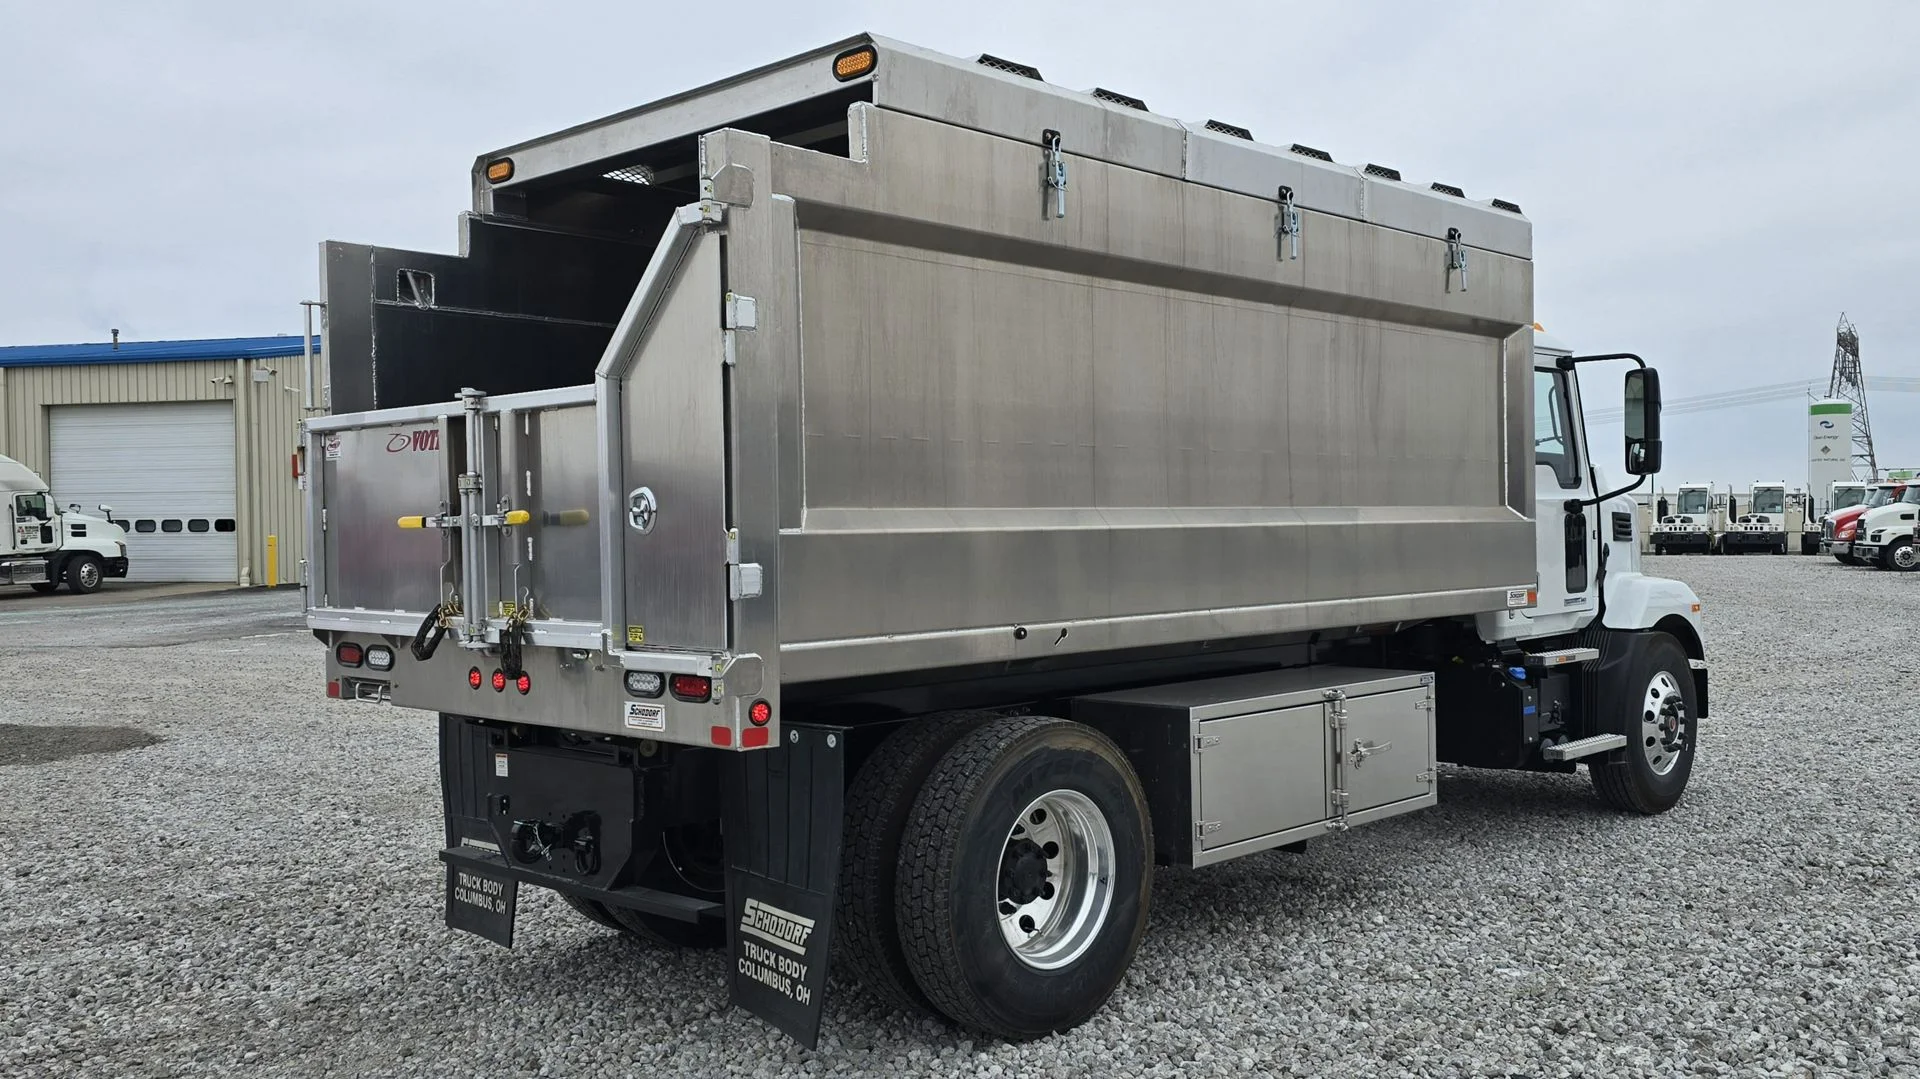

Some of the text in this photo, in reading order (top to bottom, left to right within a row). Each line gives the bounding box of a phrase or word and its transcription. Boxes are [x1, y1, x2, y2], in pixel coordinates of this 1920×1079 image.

[454, 887, 507, 915] COLUMBUS, OH
[459, 872, 504, 897] TRUCK BODY
[741, 898, 812, 946] SCHODORF
[743, 940, 808, 981] TRUCK BODY
[738, 958, 811, 1006] COLUMBUS, OH
